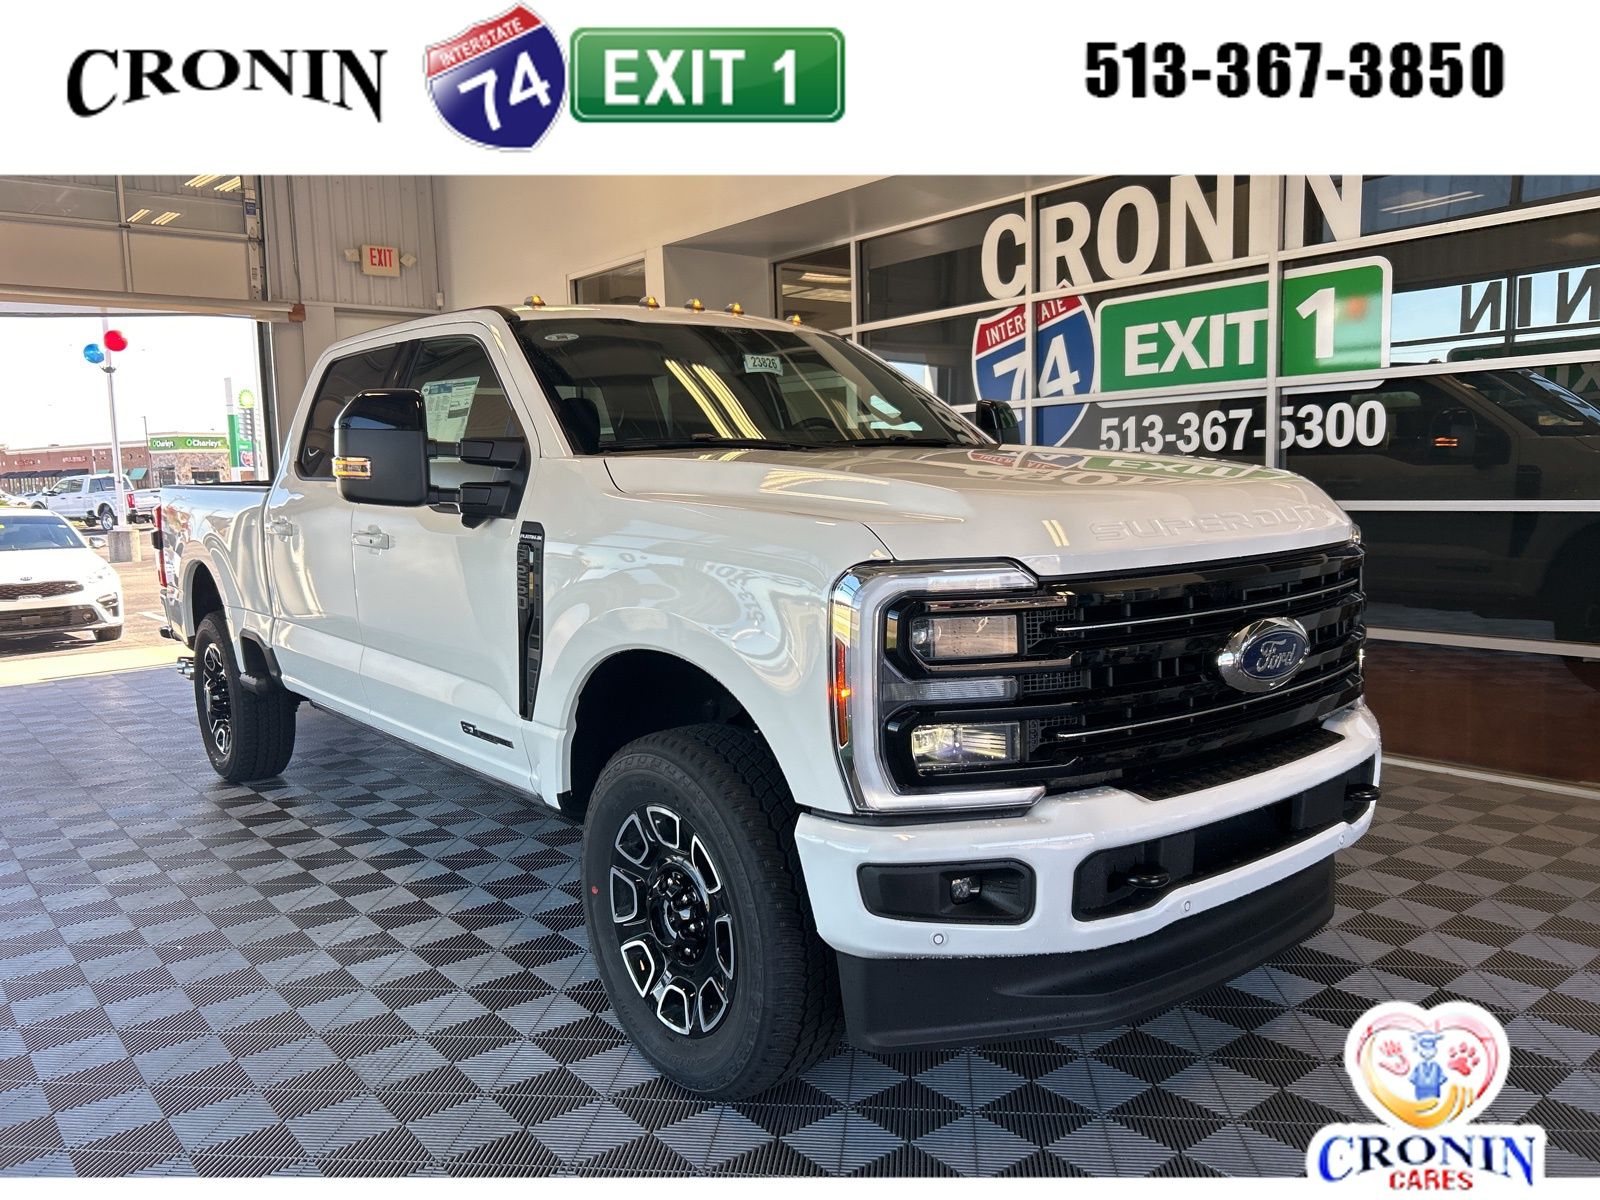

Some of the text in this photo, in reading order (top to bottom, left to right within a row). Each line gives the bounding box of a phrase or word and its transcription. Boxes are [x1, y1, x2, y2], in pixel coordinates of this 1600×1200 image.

[981, 175, 1362, 300] CRONIN
[369, 247, 393, 268] EXIT
[1125, 288, 1335, 377] EXIT 1
[751, 356, 778, 369] 23826
[993, 333, 1080, 408] 74
[1088, 511, 1253, 542] SUPER
[1256, 639, 1297, 672] Ford
